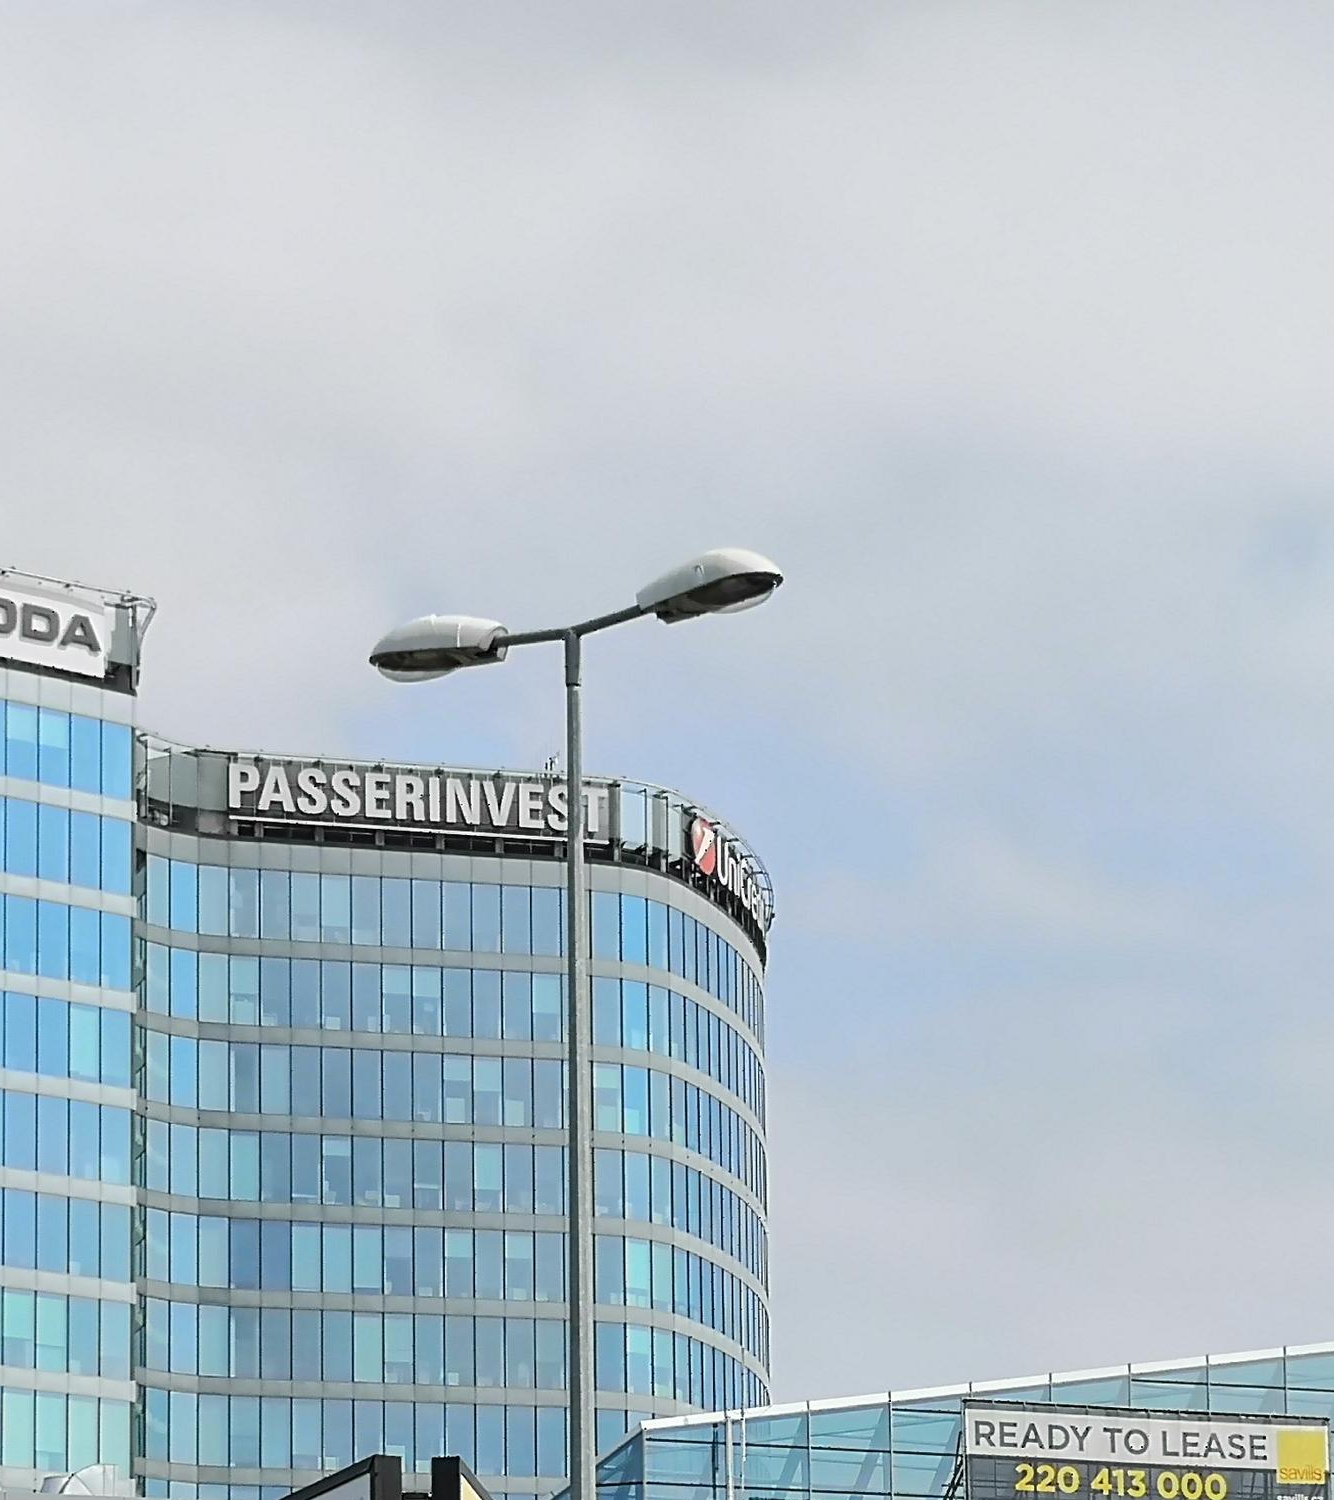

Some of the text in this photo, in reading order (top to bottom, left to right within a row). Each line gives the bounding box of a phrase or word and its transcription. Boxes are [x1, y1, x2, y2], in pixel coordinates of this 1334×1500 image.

[228, 762, 609, 834] PASSERINVEST
[973, 1420, 1268, 1461] READY TO LEASE
[1014, 1463, 1080, 1494] 220
[1090, 1467, 1147, 1498] 413
[1279, 1464, 1323, 1481] savills
